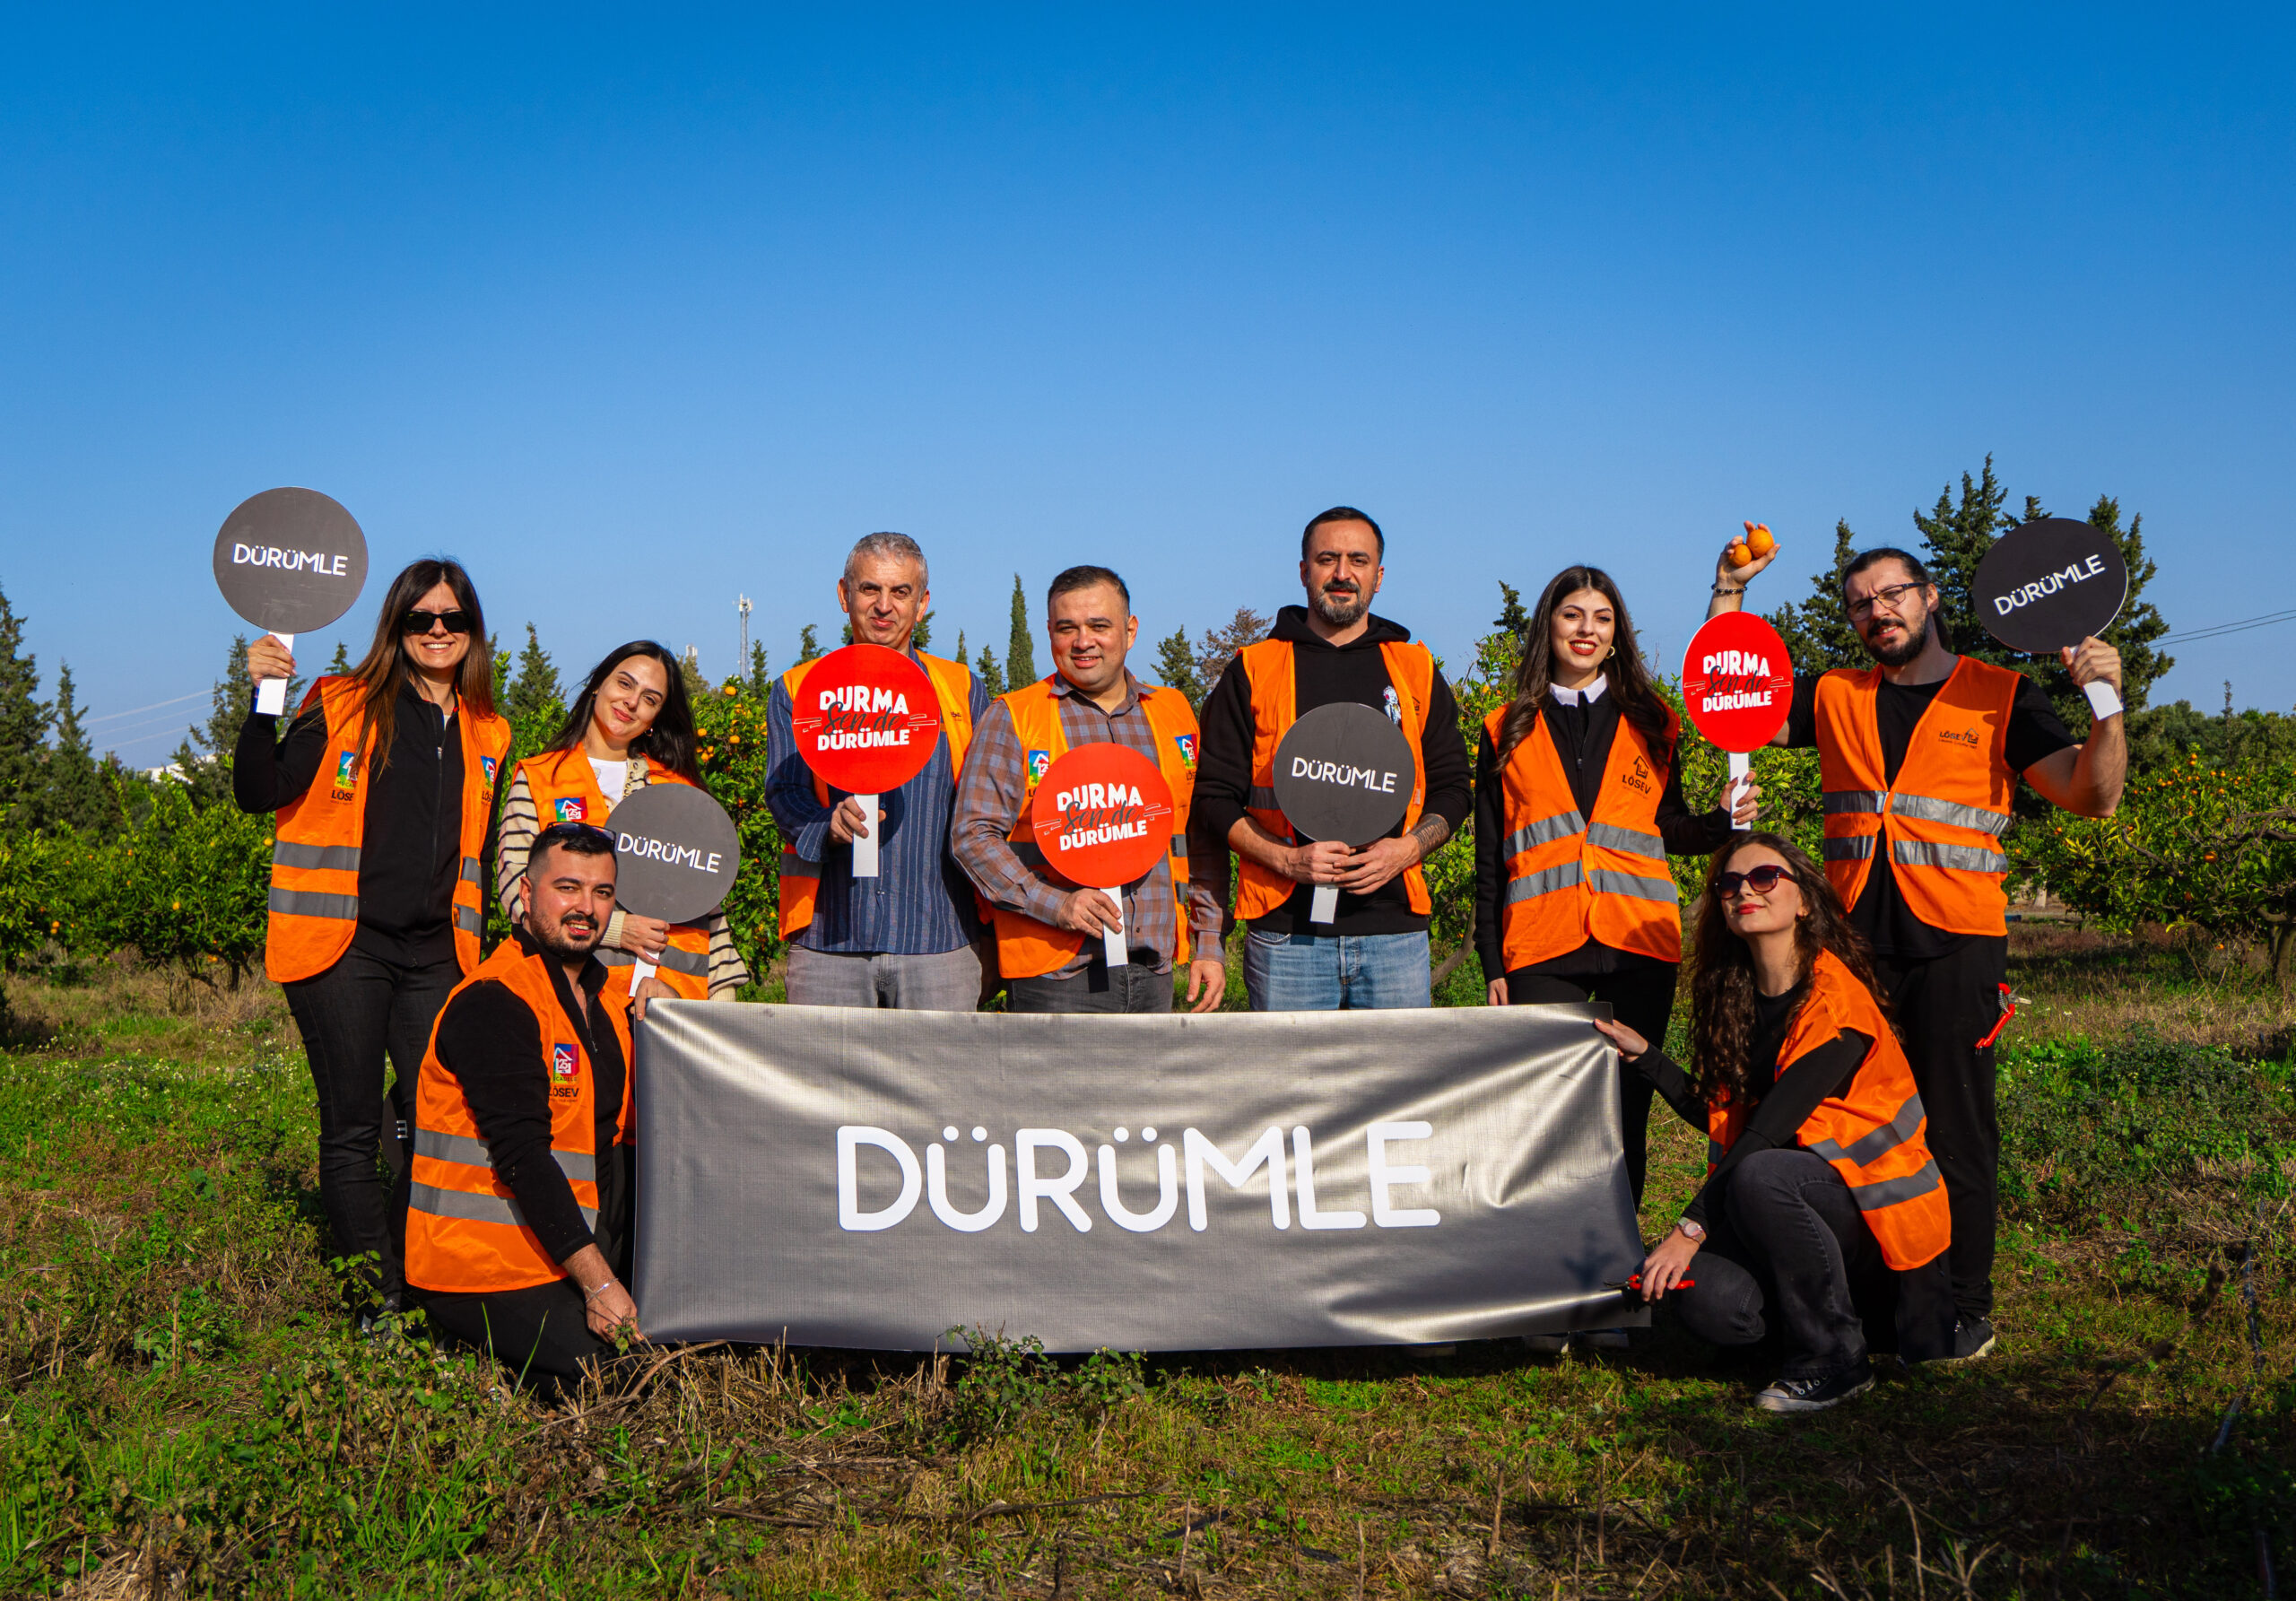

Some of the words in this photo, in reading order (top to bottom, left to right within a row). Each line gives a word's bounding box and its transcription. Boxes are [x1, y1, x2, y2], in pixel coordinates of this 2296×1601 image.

[233, 543, 349, 577] DÜRÜMLE
[1994, 553, 2106, 616] DÜRÜMLE
[1703, 650, 1770, 677] DURMA
[1707, 666, 1742, 698] Sen
[1744, 670, 1768, 693] de
[820, 685, 909, 714] DURMA
[1702, 690, 1772, 713] DÜRÜMLE
[823, 701, 869, 735] Sen
[873, 707, 905, 732] de
[817, 727, 910, 751] DÜRÜMLE
[1292, 757, 1397, 793] DÜRÜMLE
[331, 789, 354, 801] LÖSE
[1057, 783, 1144, 812] DURMA
[1064, 801, 1107, 835] Sen
[1111, 800, 1140, 825] de
[1059, 820, 1147, 851] DÜRÜMLE
[617, 832, 722, 874] DÜRÜMLE
[836, 1120, 1441, 1233] DÜRÜMLE
